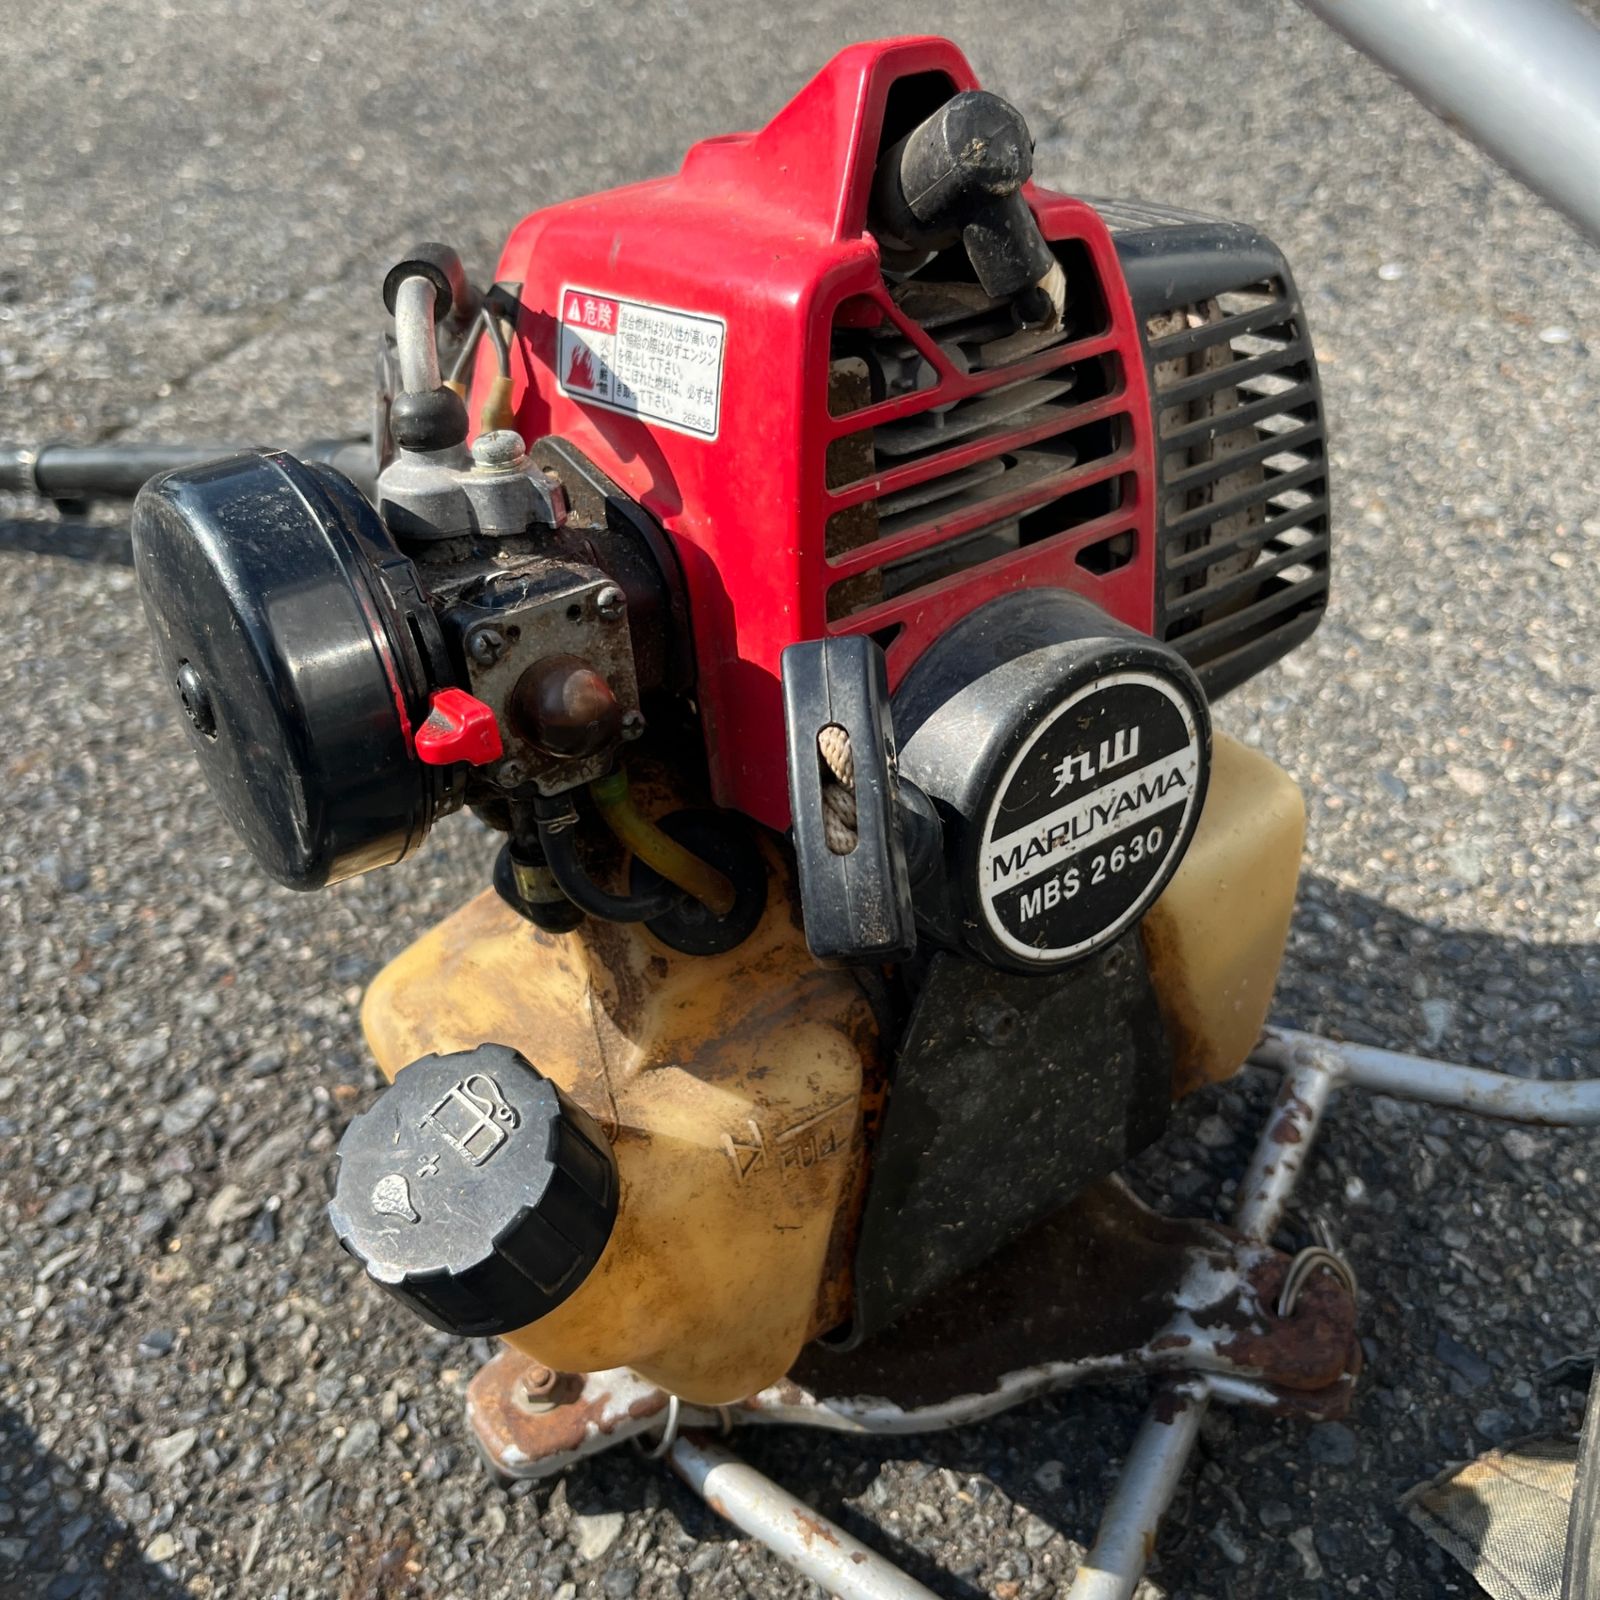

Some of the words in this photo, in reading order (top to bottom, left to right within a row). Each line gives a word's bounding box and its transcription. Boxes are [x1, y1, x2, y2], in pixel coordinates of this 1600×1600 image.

[582, 300, 613, 330] 危険
[682, 411, 712, 430] 265436
[1049, 725, 1141, 799] 丸山
[992, 767, 1188, 883] MARUYAMA
[1019, 868, 1080, 924] MBS
[1091, 824, 1164, 886] 2630
